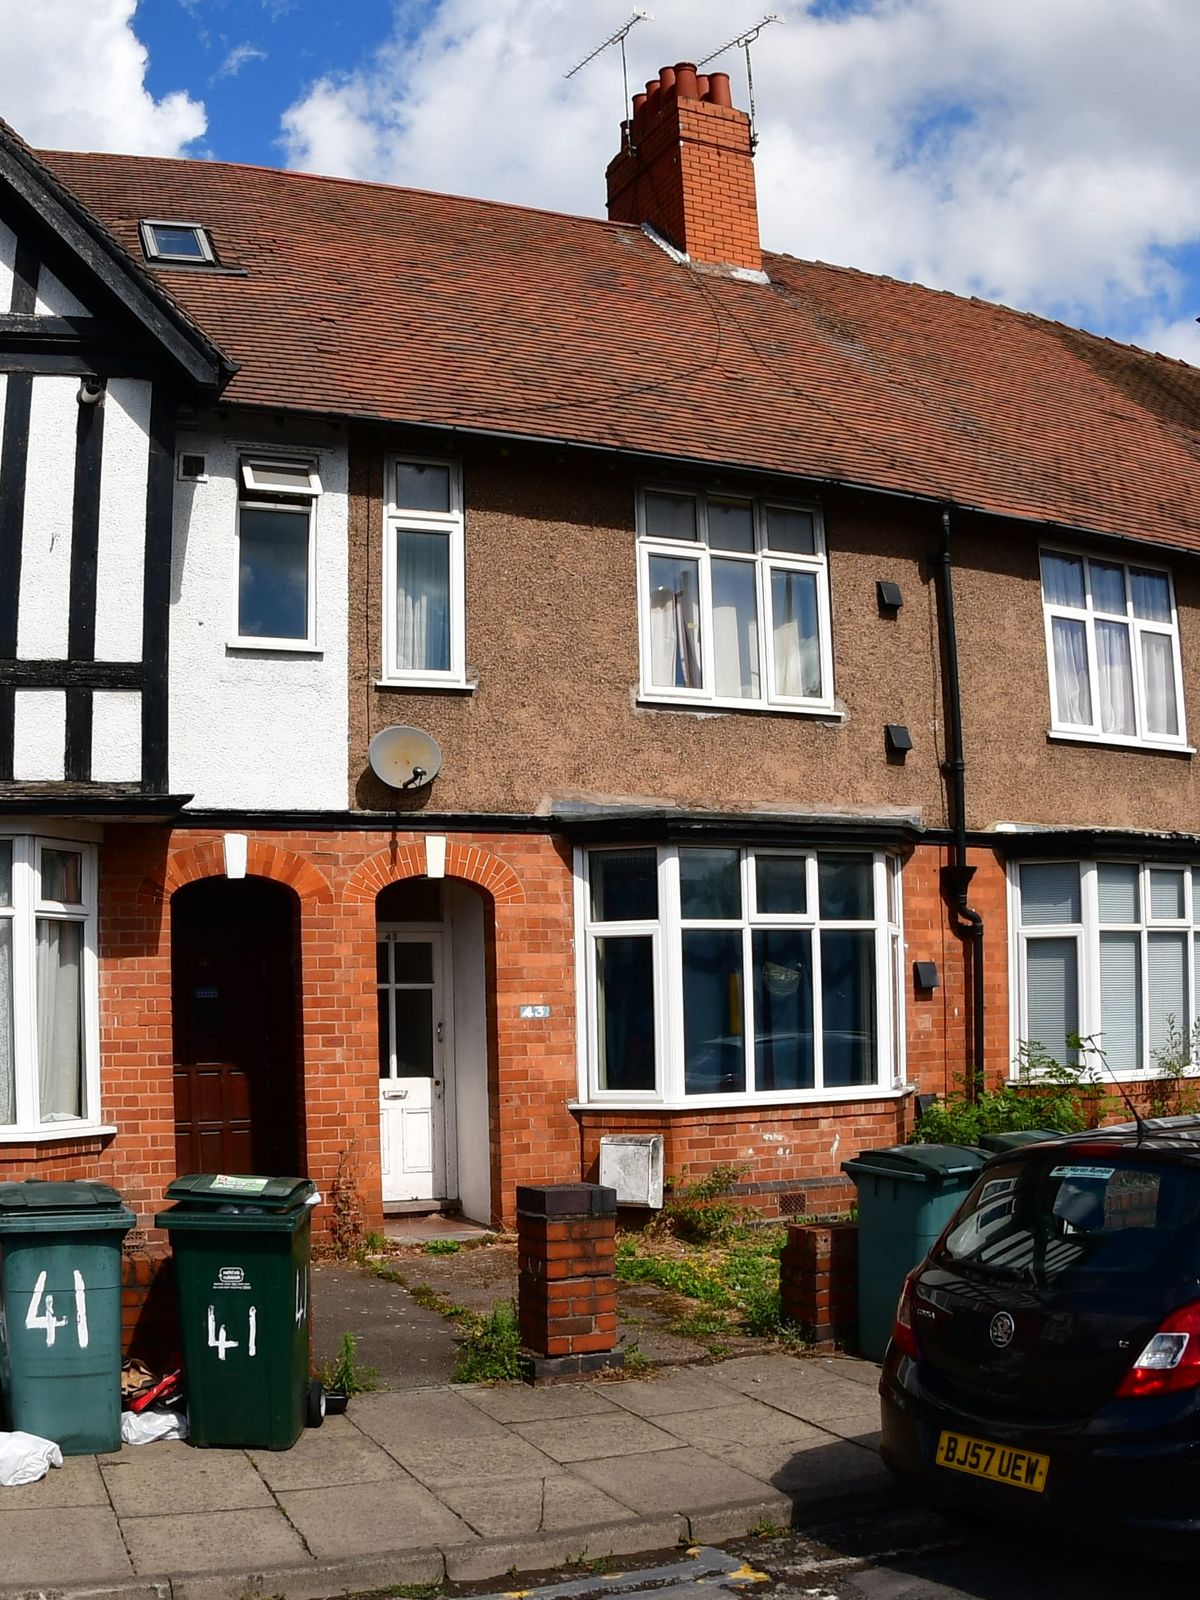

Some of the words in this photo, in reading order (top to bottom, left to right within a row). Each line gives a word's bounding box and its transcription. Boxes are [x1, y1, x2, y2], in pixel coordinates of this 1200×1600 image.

[521, 1006, 545, 1018] 43
[26, 1270, 89, 1349] 41
[207, 1304, 257, 1361] 41
[943, 1436, 996, 1473] BJ57
[998, 1446, 1040, 1485] UEW
